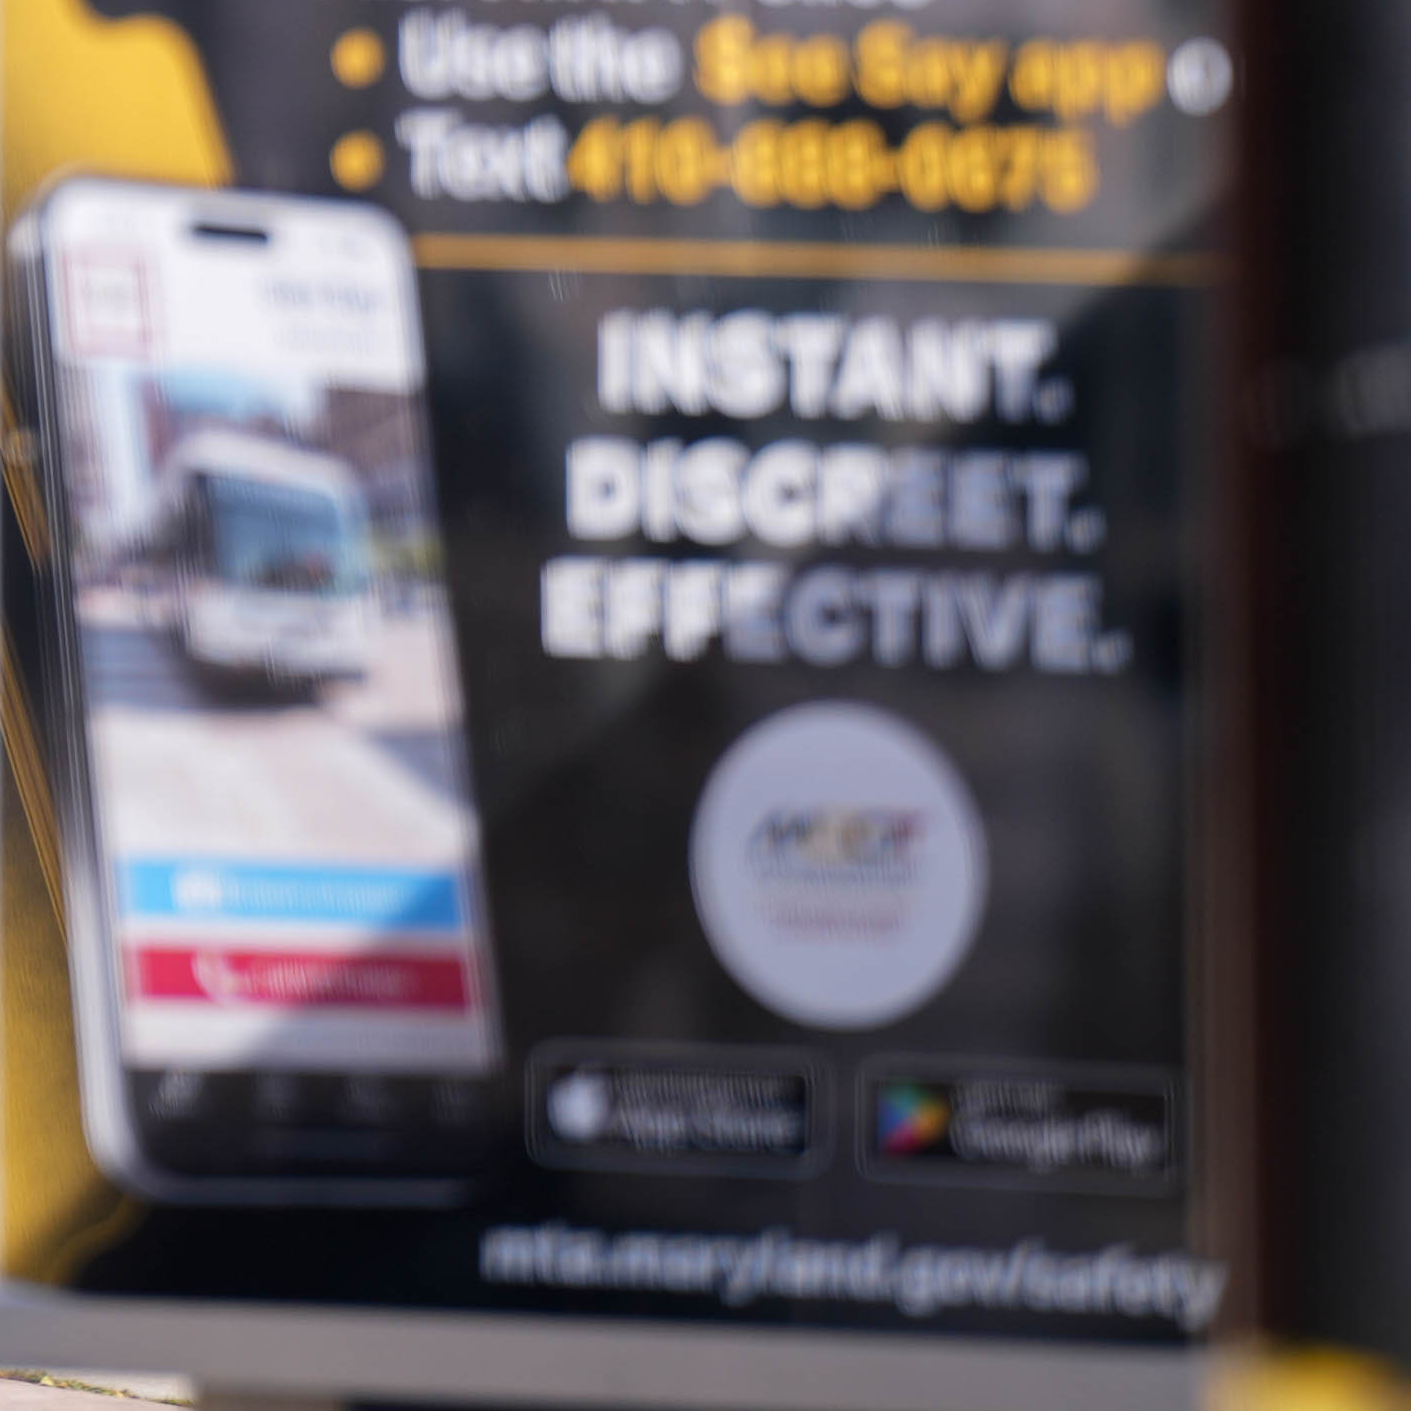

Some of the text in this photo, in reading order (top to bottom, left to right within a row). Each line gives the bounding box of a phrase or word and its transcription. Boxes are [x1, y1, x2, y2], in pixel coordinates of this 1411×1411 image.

[400, 12, 548, 99] Use
[550, 14, 683, 103] the
[696, 16, 852, 105] See
[855, 21, 1008, 122] Say
[1010, 40, 1167, 126] app
[396, 109, 569, 201] Text
[598, 310, 1073, 422] INSTANT.
[566, 437, 1105, 552] DISCREET.
[541, 556, 1131, 672] EFFECTIVE.
[483, 1221, 1226, 1330] mta.maryland.gov/safety
